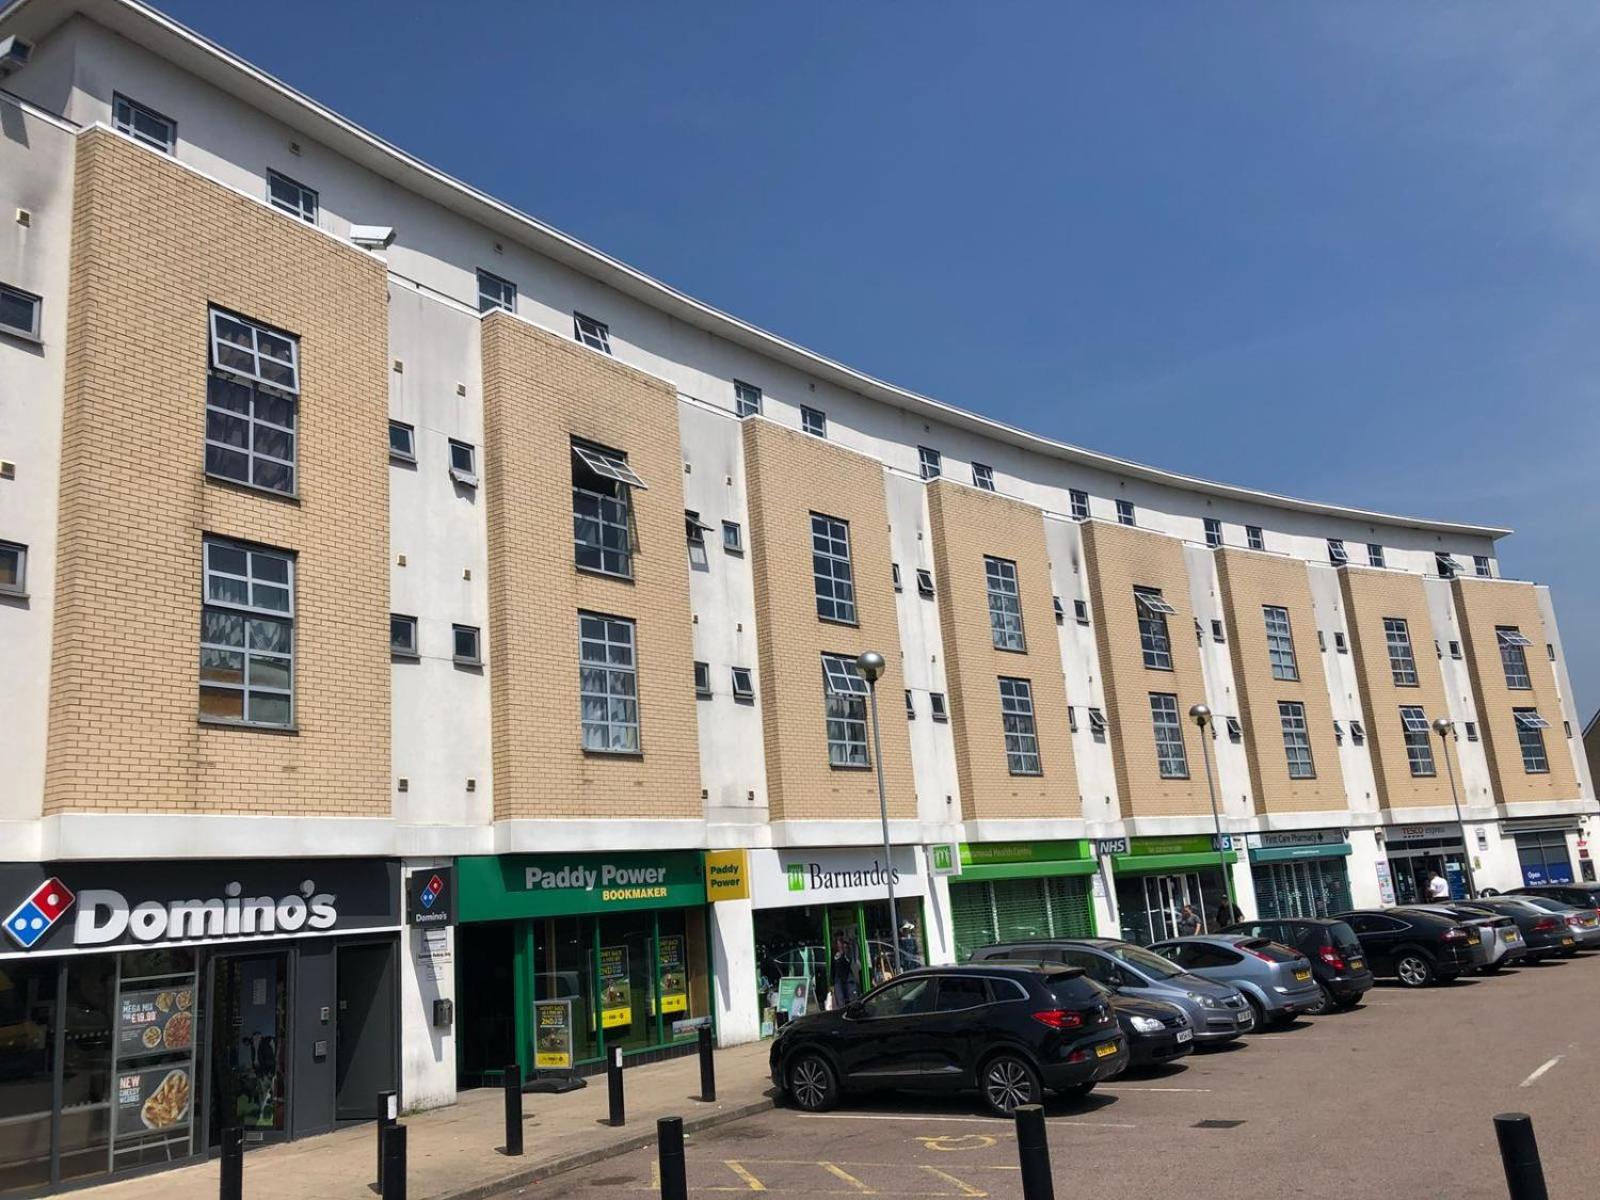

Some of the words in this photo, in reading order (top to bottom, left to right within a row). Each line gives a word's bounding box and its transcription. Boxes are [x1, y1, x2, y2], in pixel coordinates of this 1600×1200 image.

[1402, 827, 1424, 835] TESCO
[1100, 840, 1125, 853] NHS
[1213, 837, 1230, 849] NS
[711, 864, 739, 875] Paddy
[525, 866, 597, 891] Paddy
[602, 864, 666, 885] Power
[711, 878, 740, 888] Power
[603, 887, 667, 900] BOOKMAKER
[73, 880, 337, 945] Domino's
[416, 912, 447, 922] Domino's
[120, 1075, 140, 1089] NEW
